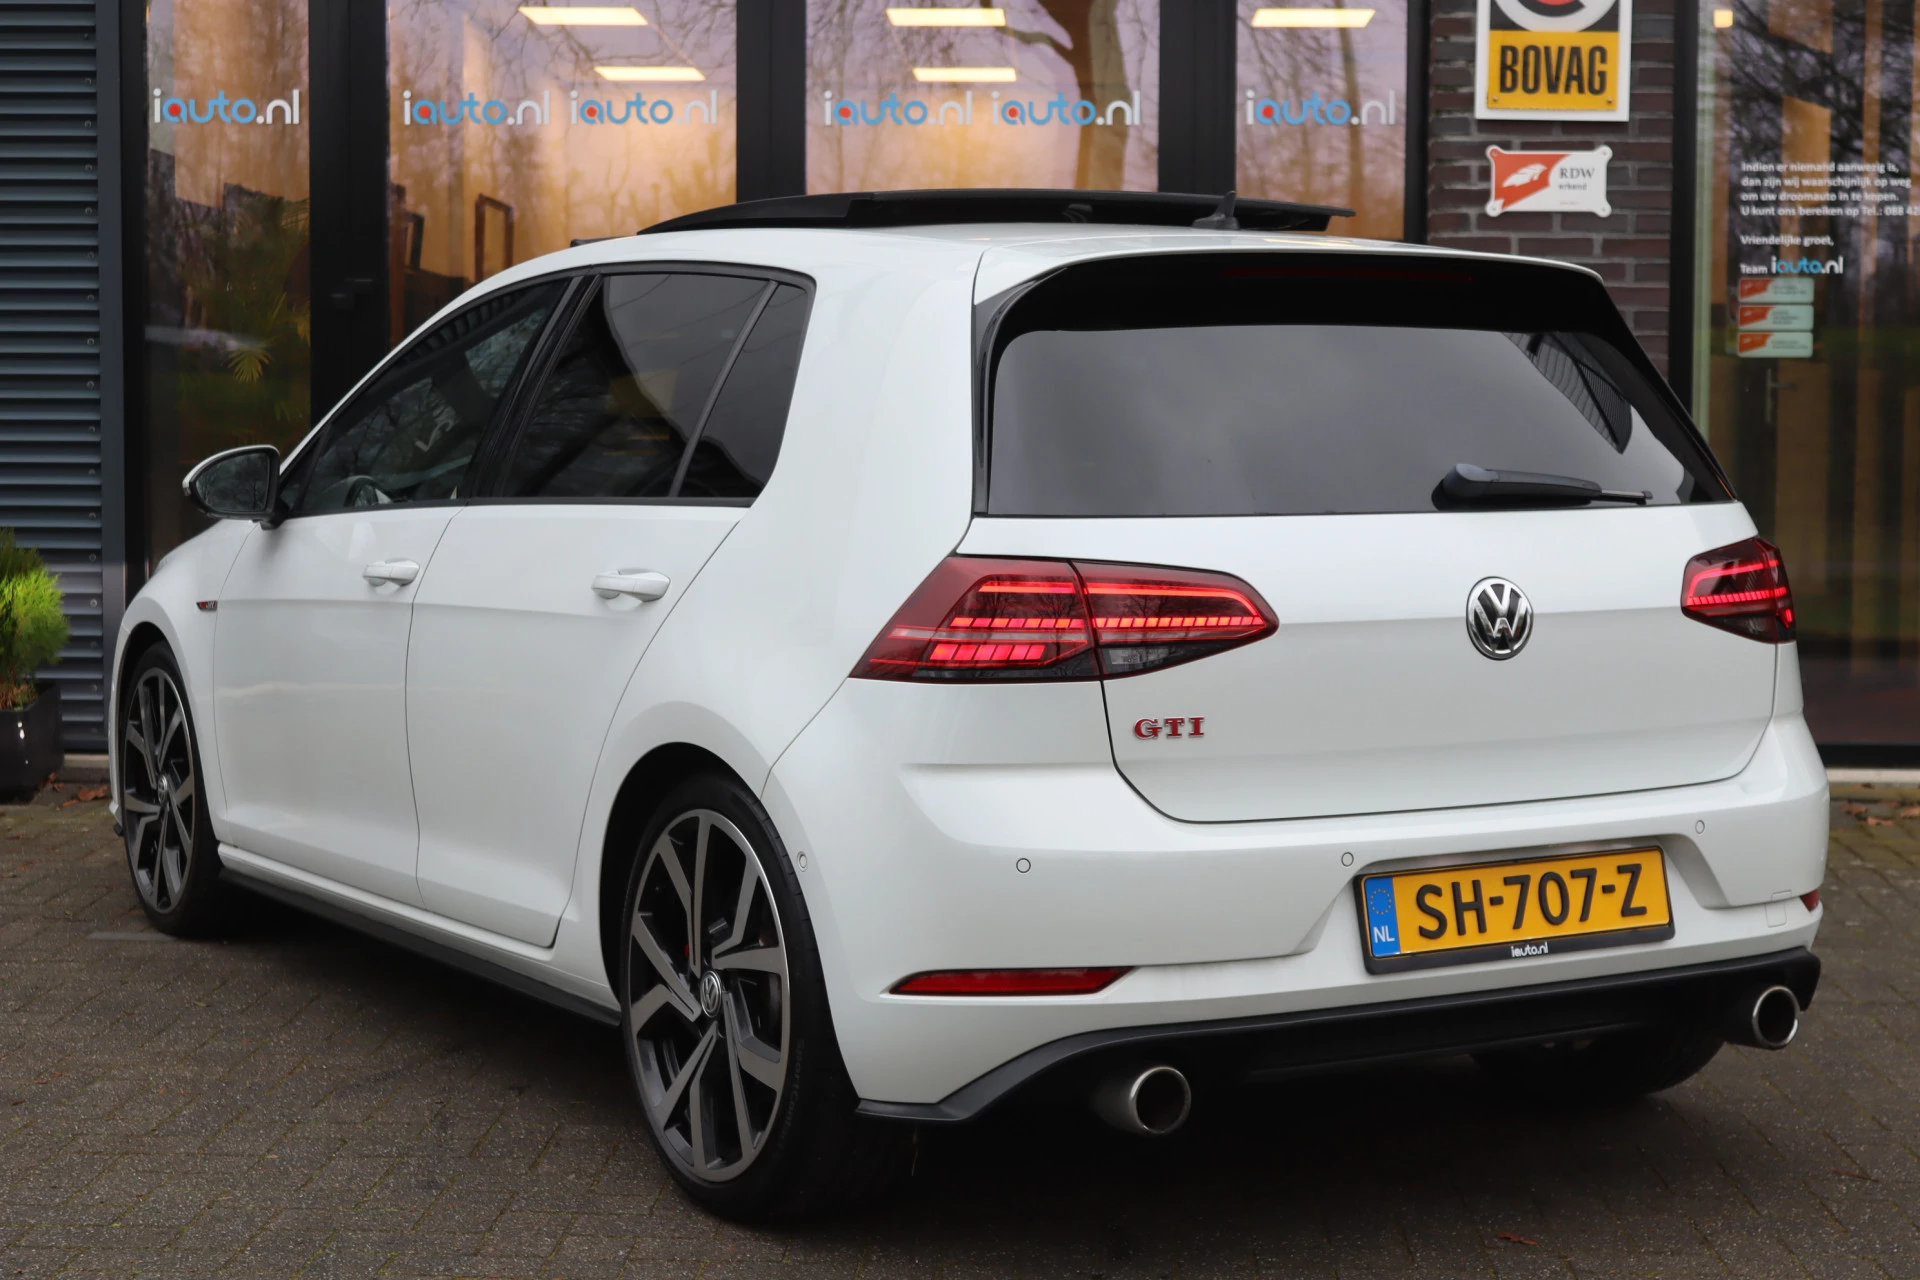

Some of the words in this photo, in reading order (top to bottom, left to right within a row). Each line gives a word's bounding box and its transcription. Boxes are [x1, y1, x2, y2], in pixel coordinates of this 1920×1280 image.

[1499, 45, 1608, 95] BOVAG
[153, 88, 300, 126] iauto.nl
[403, 89, 551, 126] iauto.nl
[570, 89, 718, 126] iauto.nl
[824, 90, 973, 126] iauto.nl
[992, 90, 1141, 126] iauto.nl
[1245, 90, 1396, 126] iauto.nl
[1559, 167, 1595, 179] RDW
[1741, 162, 1774, 172] Indien
[1776, 163, 1787, 172] er
[1789, 161, 1835, 172] niemand
[1837, 162, 1885, 174] aanwezig
[1559, 182, 1587, 191] erkend
[1741, 176, 1761, 186] dan
[1763, 176, 1781, 188] zijn
[1783, 176, 1799, 188] wij
[1801, 176, 1871, 188] waarschijnlijk
[1874, 178, 1888, 188] op
[1890, 178, 1912, 189] weg
[1741, 192, 1758, 201] om
[1760, 192, 1777, 201] uw
[1779, 191, 1837, 201] droomauto
[1838, 191, 1849, 201] in
[1850, 191, 1862, 201] te
[1741, 205, 1749, 216] U
[1751, 205, 1776, 216] kunt
[1777, 207, 1796, 216] ons
[1798, 205, 1844, 216] bereiken
[1845, 207, 1860, 218] op
[1740, 233, 1801, 247] Vriendelijke
[1803, 234, 1834, 247] groet,
[1740, 263, 1768, 274] Team
[1771, 255, 1844, 275] iauto.nl
[1133, 715, 1206, 740] GTI
[1416, 863, 1648, 940] SH-707-Z
[1373, 925, 1396, 944] NL
[1510, 941, 1549, 958] iauto.nl
